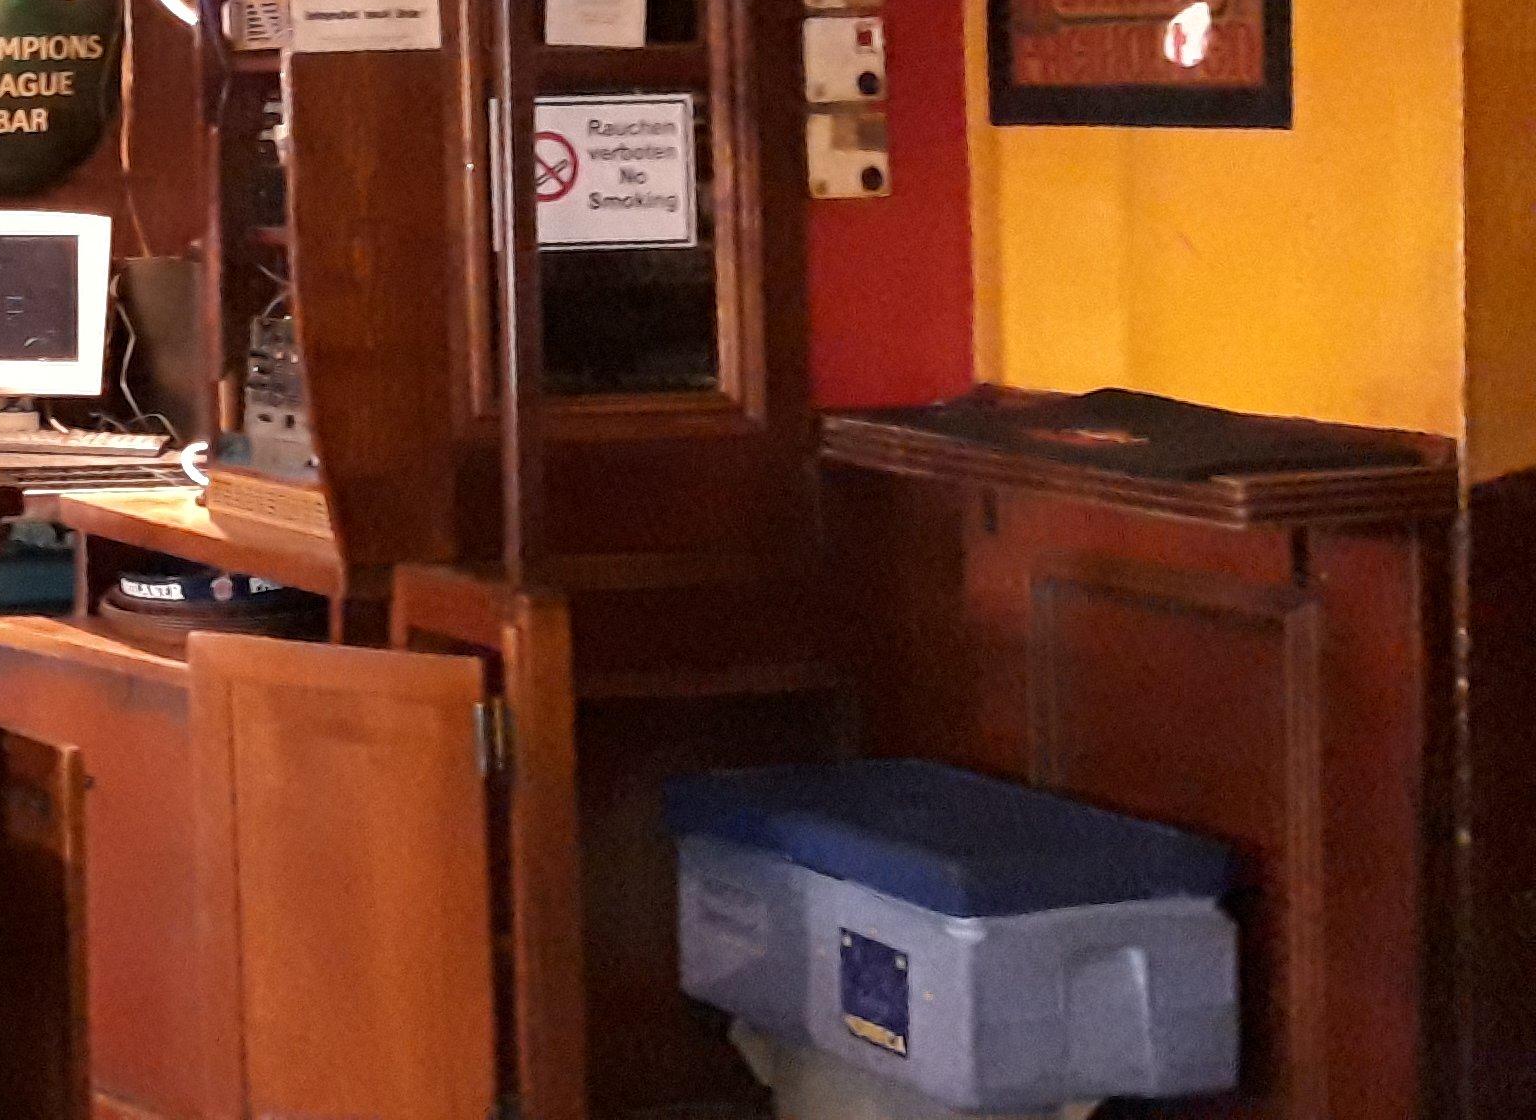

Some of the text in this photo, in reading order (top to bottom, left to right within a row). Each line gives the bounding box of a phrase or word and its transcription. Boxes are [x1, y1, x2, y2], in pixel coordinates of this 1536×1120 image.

[589, 119, 676, 136] Rauchen
[589, 145, 677, 161] verboten
[620, 167, 647, 185] No
[589, 191, 677, 213] Smoking
